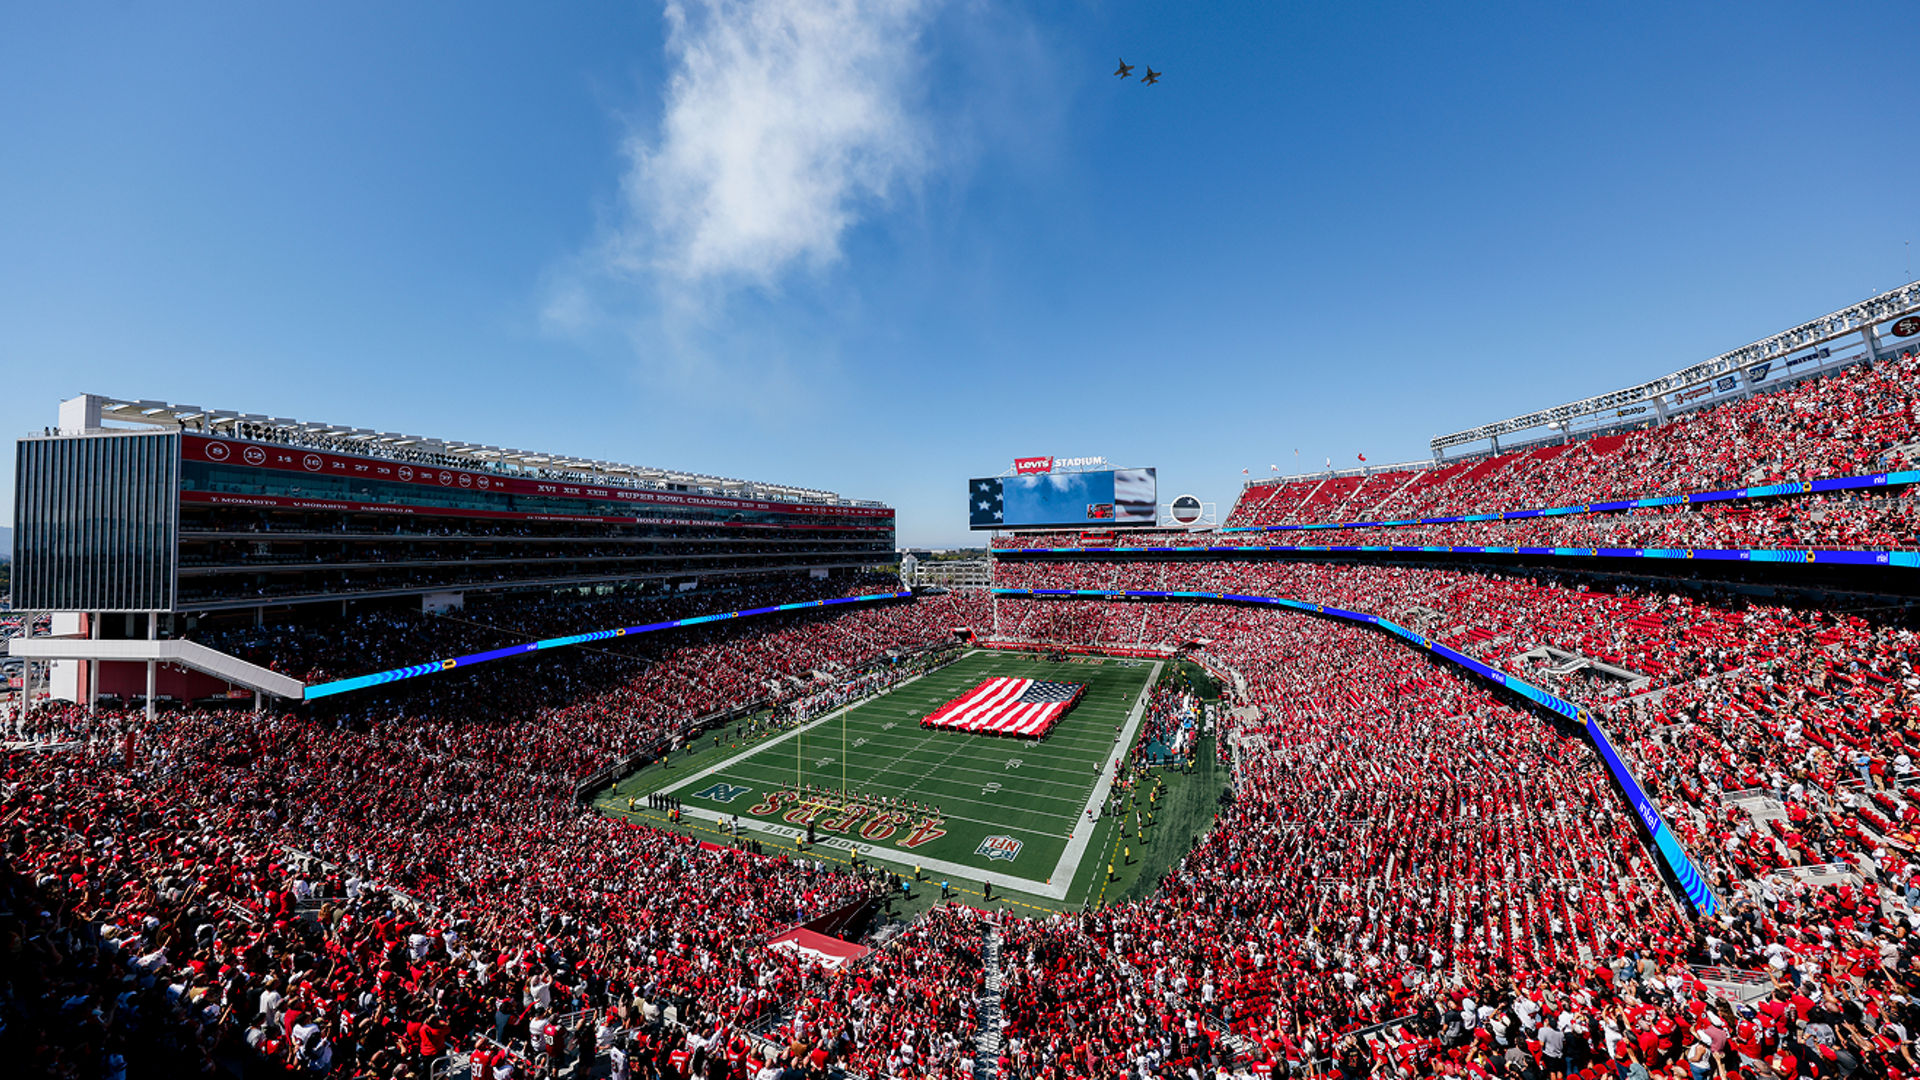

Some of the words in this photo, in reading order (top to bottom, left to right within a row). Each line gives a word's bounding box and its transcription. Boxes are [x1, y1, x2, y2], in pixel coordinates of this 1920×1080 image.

[1054, 456, 1102, 467] STADIUM
[537, 484, 556, 493] XVI
[563, 487, 580, 495] XIX
[617, 492, 655, 501] SUPER
[656, 495, 685, 504] BOWL
[687, 496, 738, 507] CHAMPIONS
[1639, 798, 1658, 830] intel
[988, 838, 1019, 852] NFL
